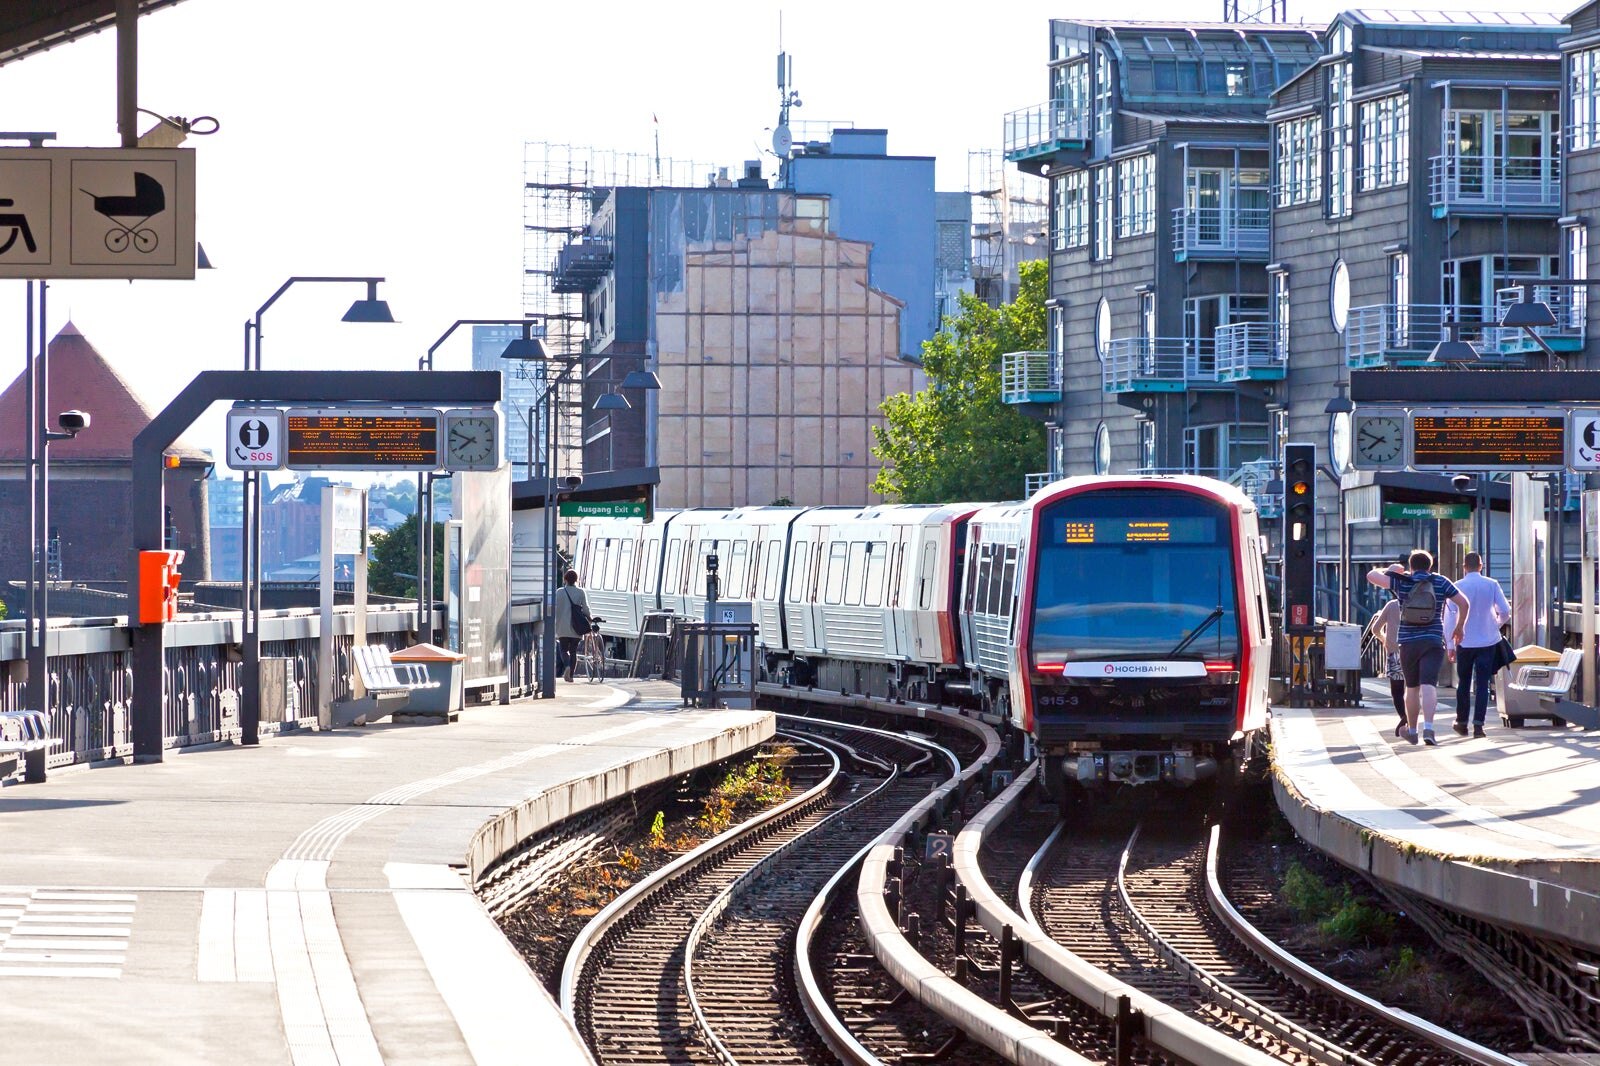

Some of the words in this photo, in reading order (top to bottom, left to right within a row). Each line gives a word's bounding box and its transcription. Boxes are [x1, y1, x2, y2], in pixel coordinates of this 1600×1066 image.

[250, 452, 273, 461] SOS
[577, 505, 612, 515] Ausgang
[614, 505, 629, 514] Exit
[1402, 507, 1436, 516] Ausgang
[1438, 507, 1453, 515] Exit
[1115, 665, 1168, 673] HOCHBAHN
[1039, 696, 1079, 706] 315-3
[931, 839, 947, 859] 2
